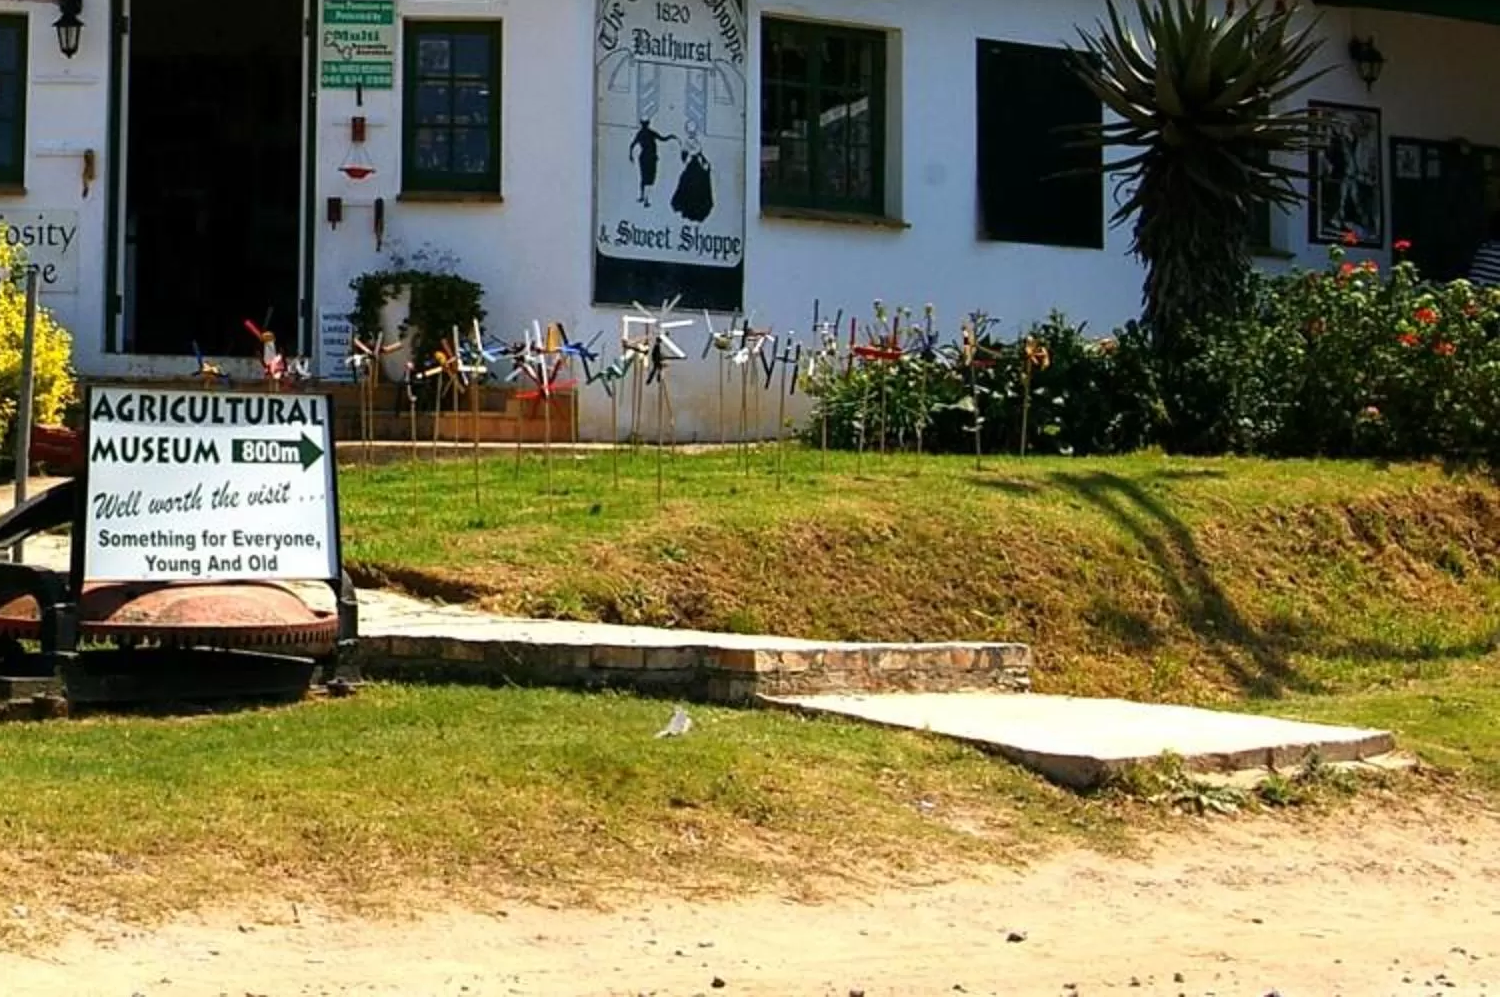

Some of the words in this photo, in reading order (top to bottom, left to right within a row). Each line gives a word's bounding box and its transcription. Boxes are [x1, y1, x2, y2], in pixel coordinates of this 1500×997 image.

[598, 2, 625, 50] The
[655, 1, 691, 24] 1820
[632, 28, 712, 62] Bathurst
[614, 219, 673, 249] Sweet
[678, 225, 741, 260] Shoppe
[93, 392, 325, 425] AGRICULTURAL
[91, 436, 220, 464] MUSEUM
[242, 442, 299, 462] 800m
[93, 490, 142, 520] Well
[149, 483, 203, 514] worth
[211, 480, 240, 510] the
[247, 481, 291, 504] visit
[99, 529, 196, 550] Something
[202, 530, 227, 547] for
[233, 530, 321, 551] Everyone,
[145, 555, 202, 576] Young
[207, 555, 242, 572] And
[249, 555, 278, 572] Old
